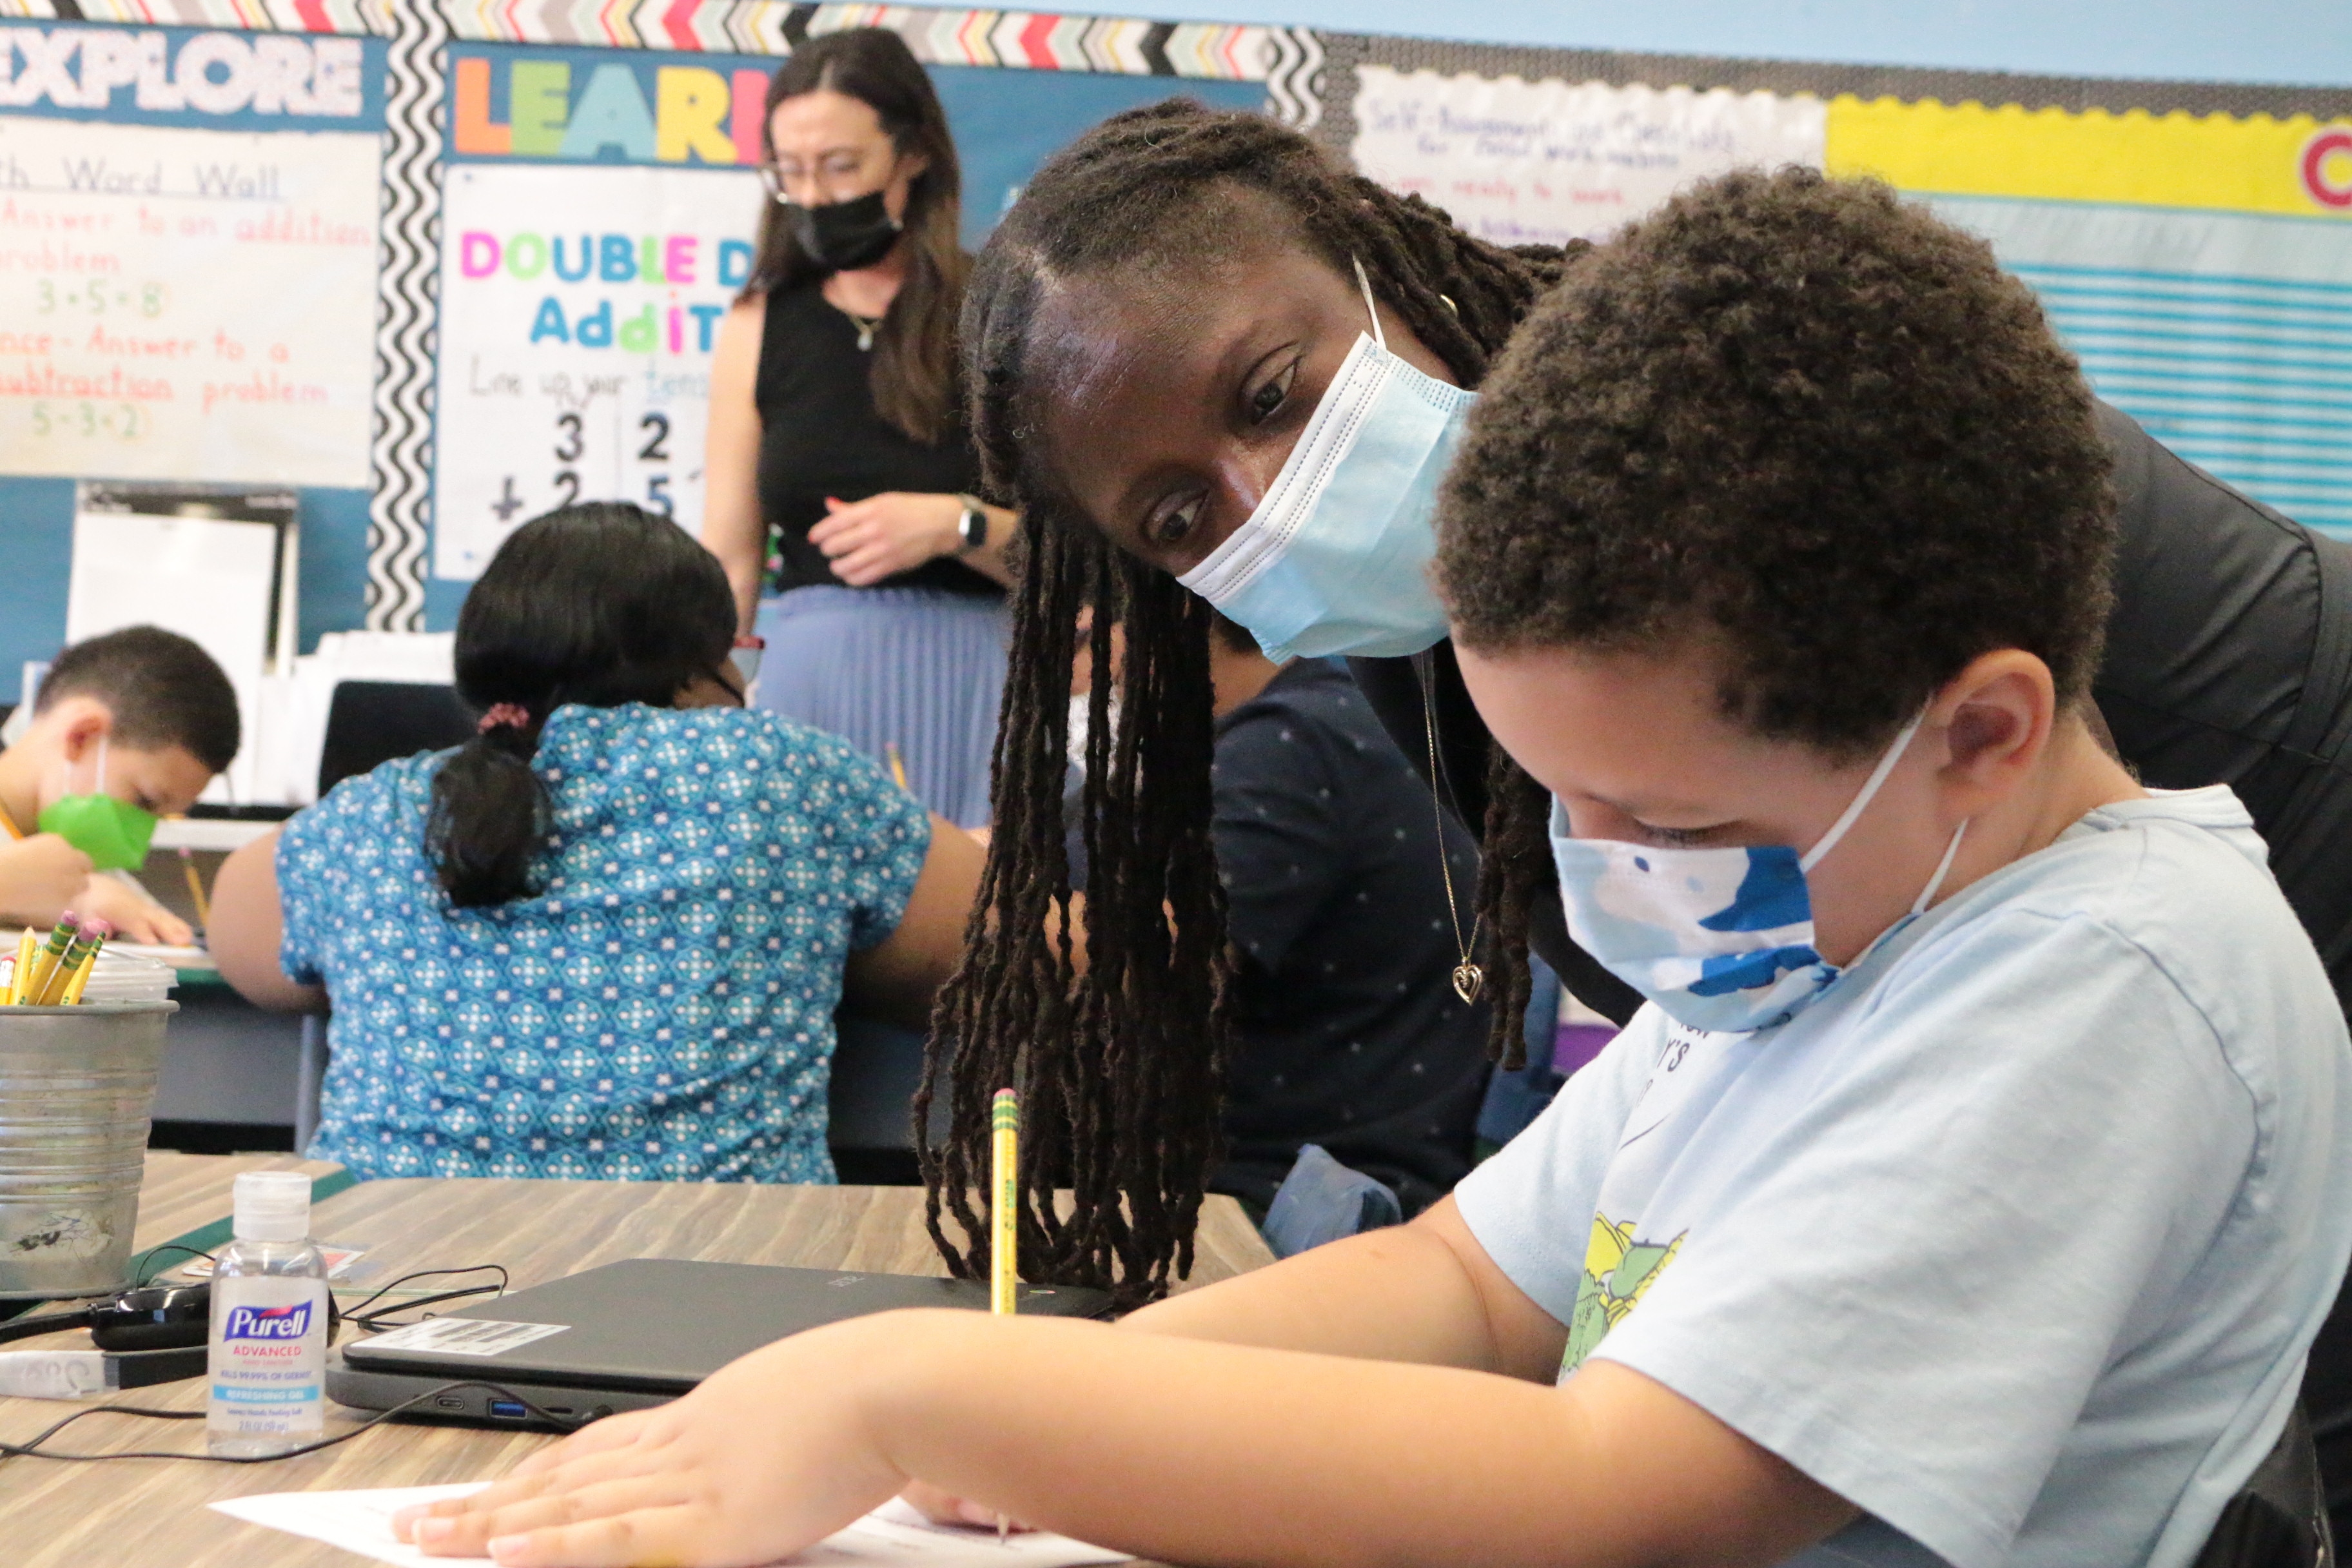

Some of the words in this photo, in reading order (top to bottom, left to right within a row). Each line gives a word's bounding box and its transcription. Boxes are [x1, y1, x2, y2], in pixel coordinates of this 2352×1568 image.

[0, 27, 362, 116] XPLORE
[62, 157, 162, 194] Word
[193, 161, 280, 199] Wall
[3, 197, 115, 232] Answer
[137, 203, 166, 237] to
[179, 213, 219, 237] an
[233, 206, 372, 246] addition
[0, 239, 122, 275] roblem
[460, 231, 699, 284] DOUBLE
[86, 324, 200, 359] Answer
[213, 328, 245, 363] to
[268, 342, 291, 364] a
[0, 359, 175, 401] ubtraction
[201, 368, 329, 415] problem
[554, 413, 584, 462] 3
[638, 411, 671, 460] 2
[232, 1308, 307, 1337] Purell
[233, 1345, 302, 1357] ADVANCED
